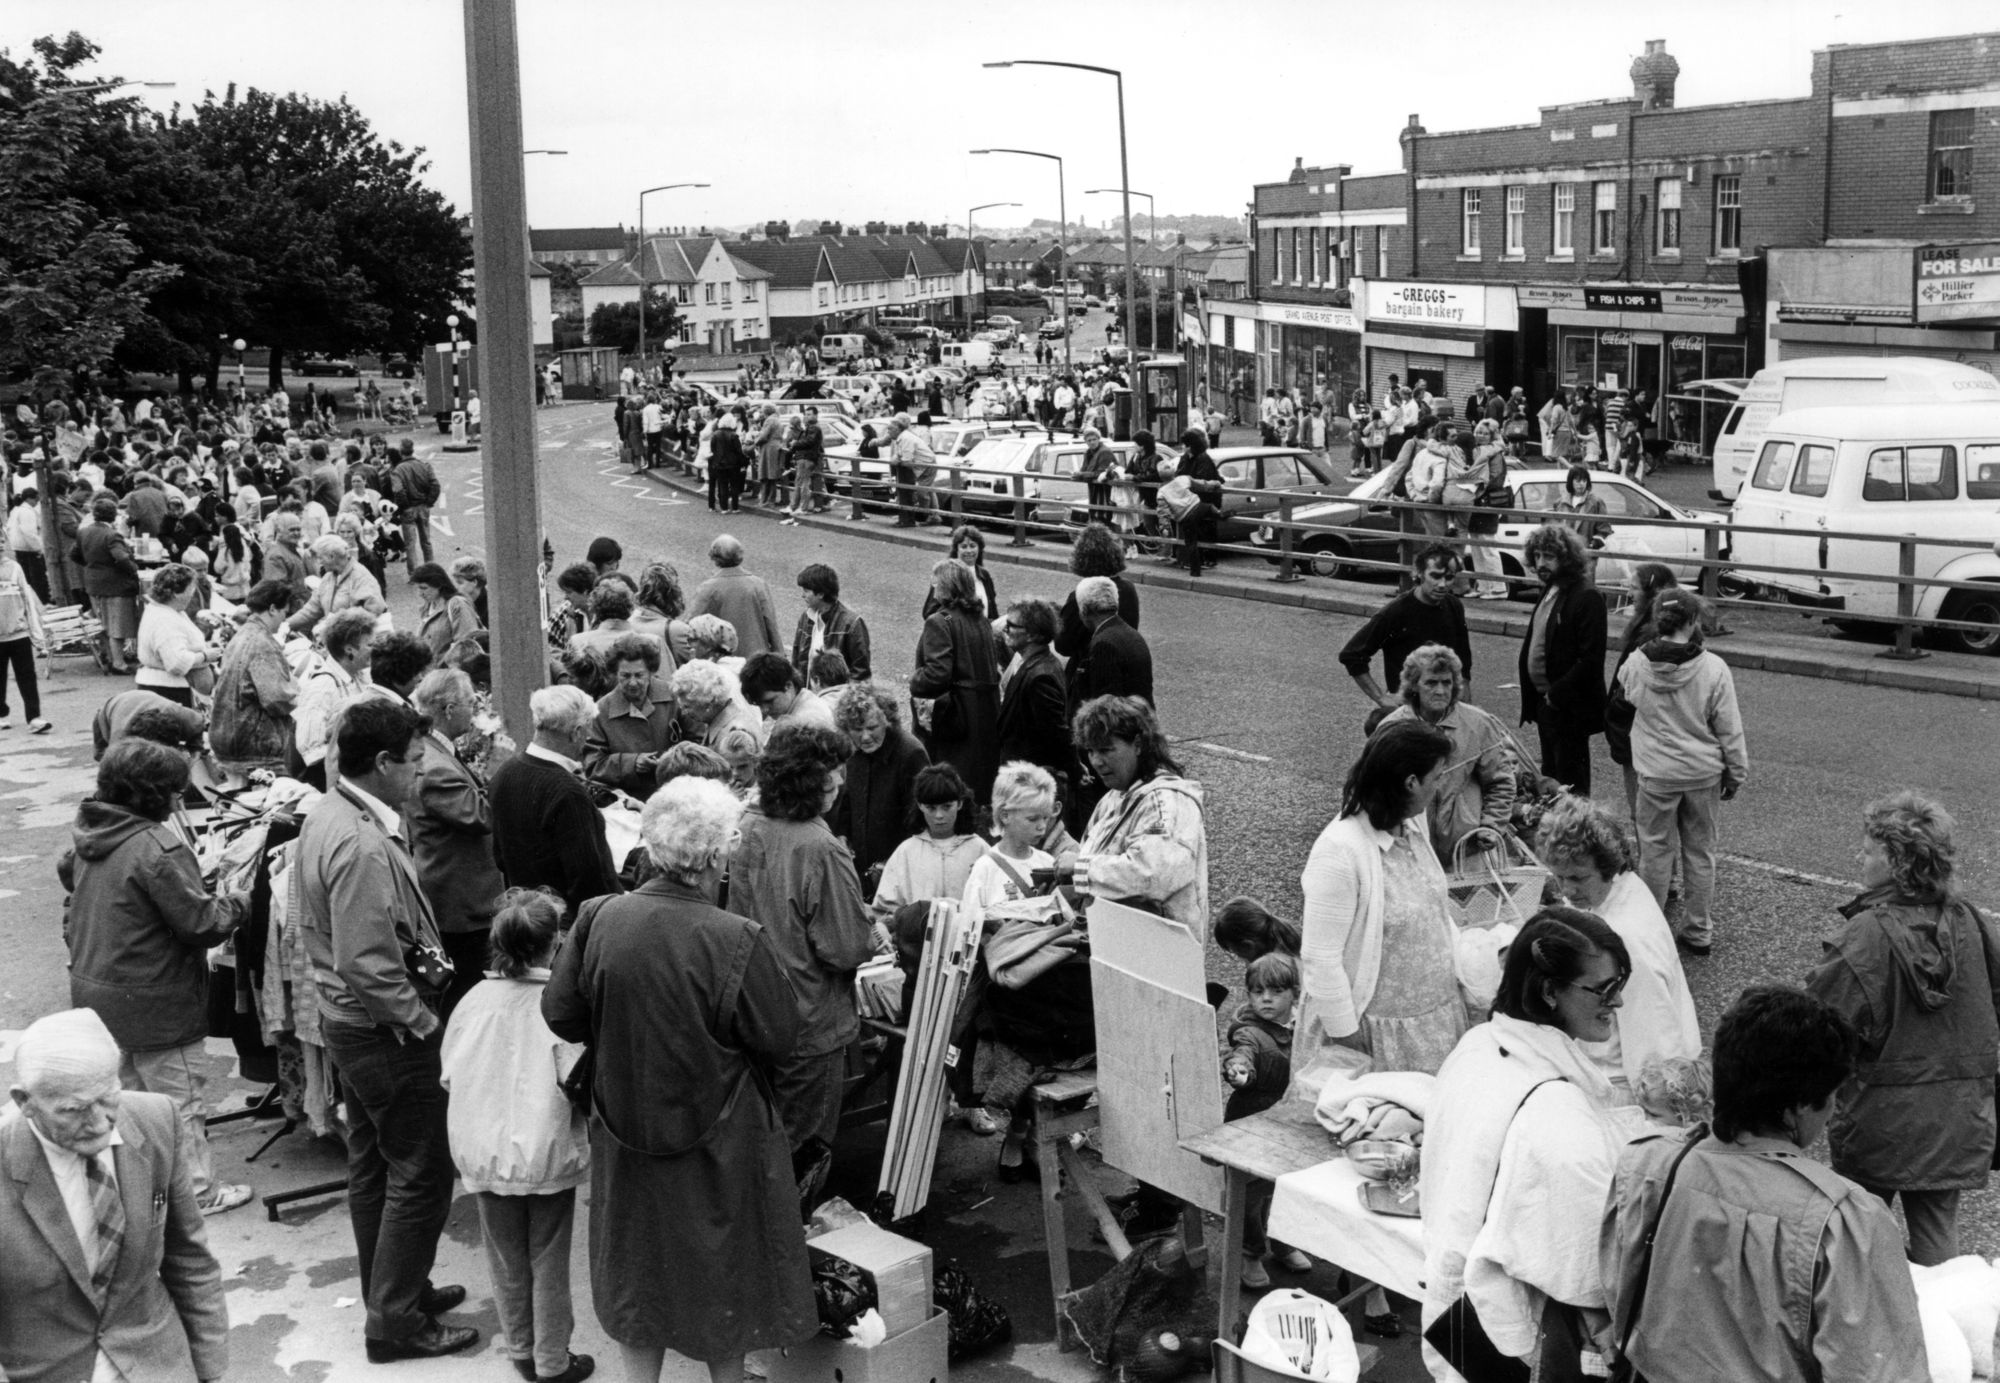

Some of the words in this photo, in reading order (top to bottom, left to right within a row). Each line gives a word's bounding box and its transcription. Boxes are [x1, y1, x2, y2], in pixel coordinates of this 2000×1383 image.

[1922, 249, 1959, 260] LEASE
[1922, 260, 1956, 276] FOR
[1960, 257, 2000, 273] SALE
[1942, 281, 1974, 291] Hillier
[1600, 295, 1615, 304] FISH
[1624, 296, 1645, 306] CHIPS
[1942, 292, 1974, 301] Parker
[1386, 301, 1422, 318] bargain
[1427, 304, 1464, 322] bakery
